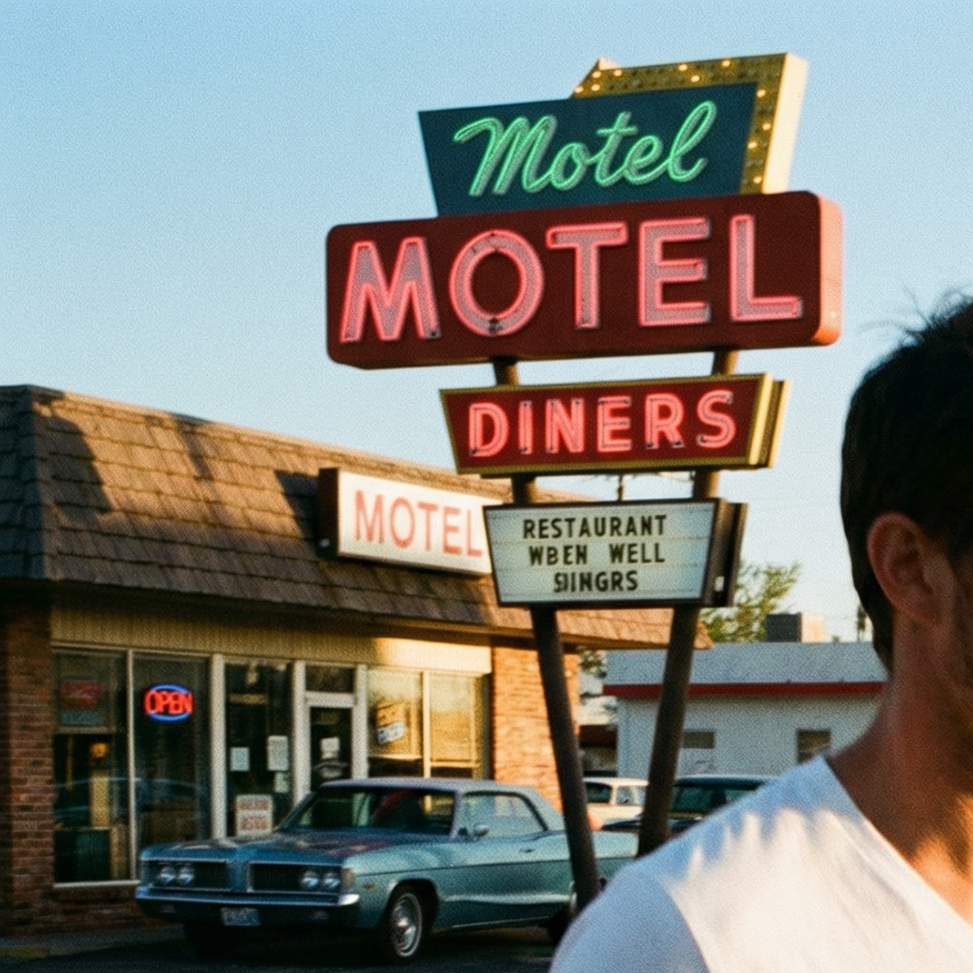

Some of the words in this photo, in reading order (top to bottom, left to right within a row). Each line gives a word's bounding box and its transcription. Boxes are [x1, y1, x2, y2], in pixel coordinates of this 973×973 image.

[453, 100, 717, 197] Motel
[340, 214, 803, 343] MOTEL
[467, 390, 737, 457] DINERS
[354, 489, 484, 558] MOTEL
[523, 514, 667, 539] RESTAURANT
[609, 543, 666, 563] WELL
[144, 689, 194, 715] OPEN
